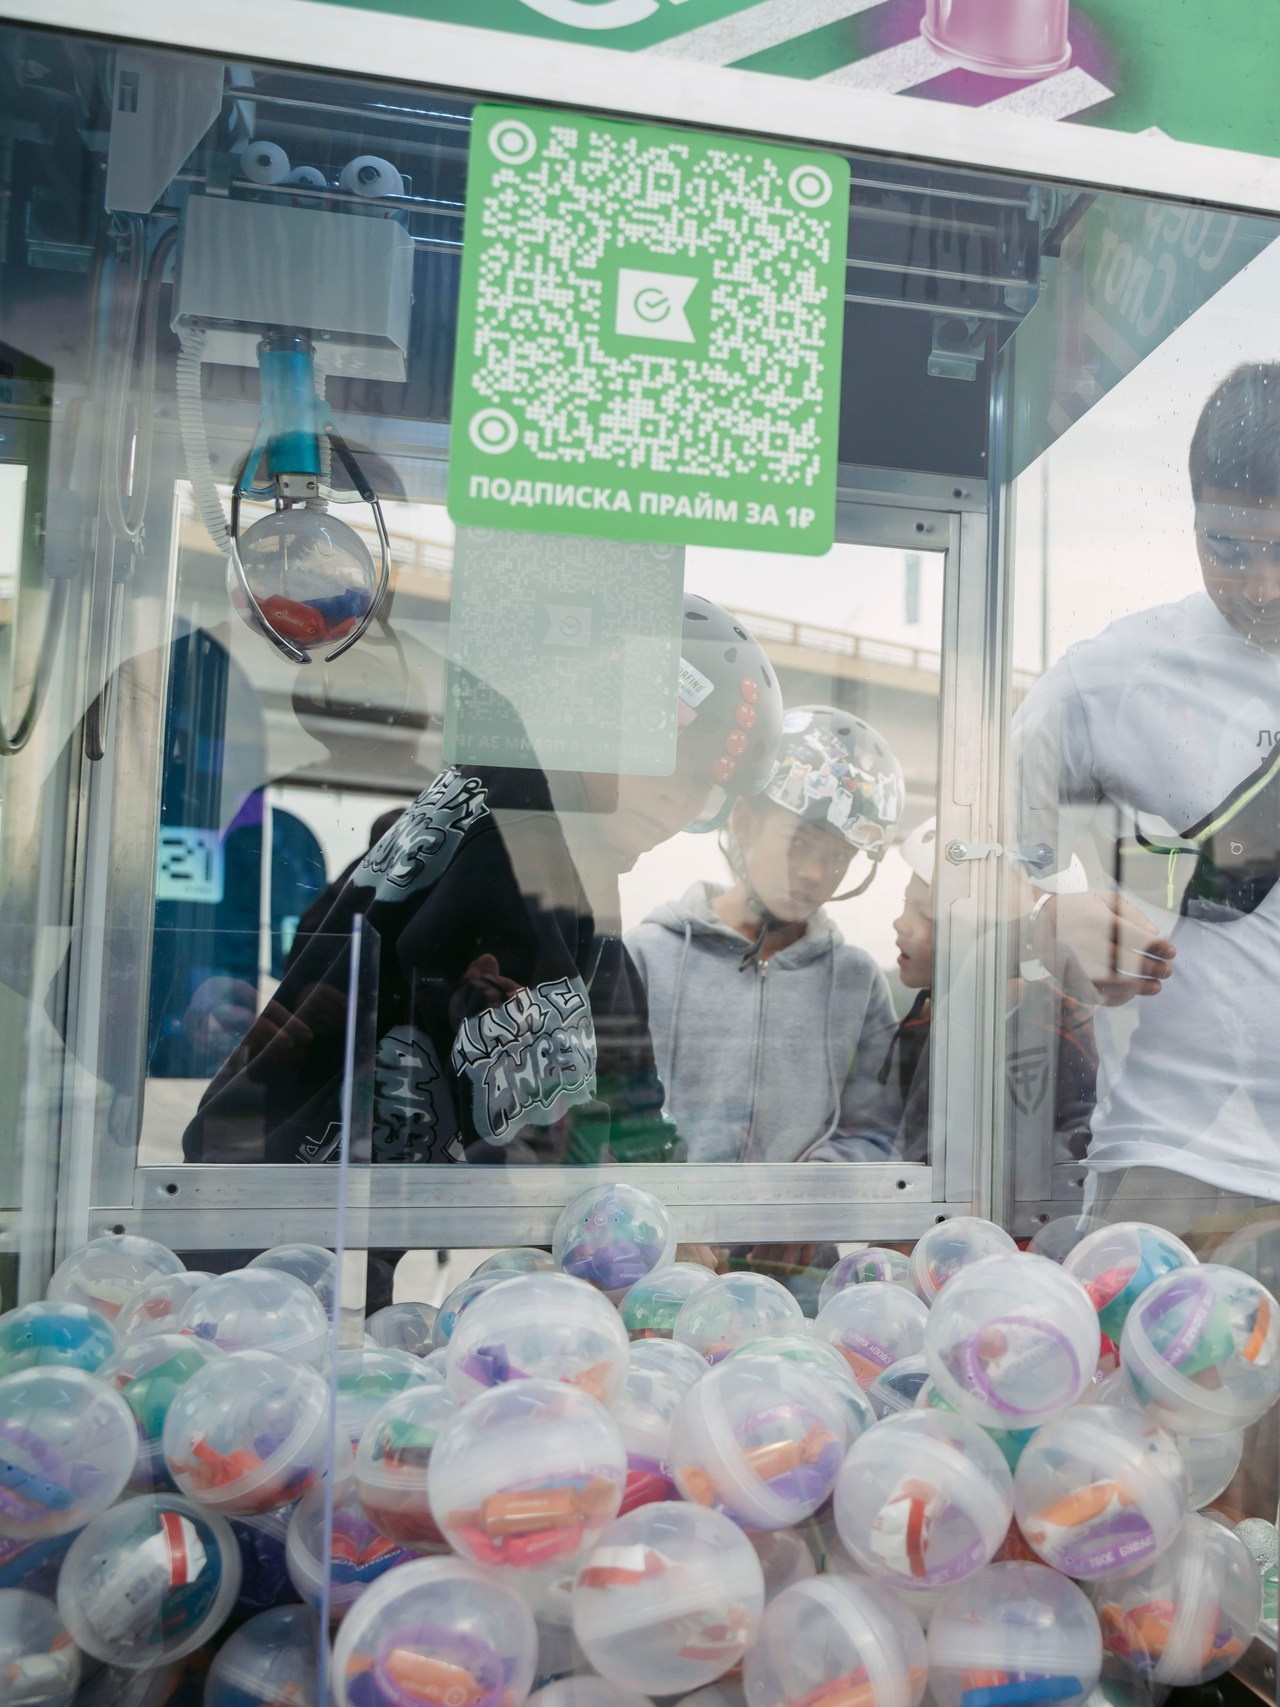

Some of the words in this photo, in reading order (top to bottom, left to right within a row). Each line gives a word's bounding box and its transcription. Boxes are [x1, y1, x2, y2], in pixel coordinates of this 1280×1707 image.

[469, 475, 632, 513] ПОДПИСКА
[639, 491, 738, 522] ПРАЙМ
[745, 502, 780, 526] ЗА
